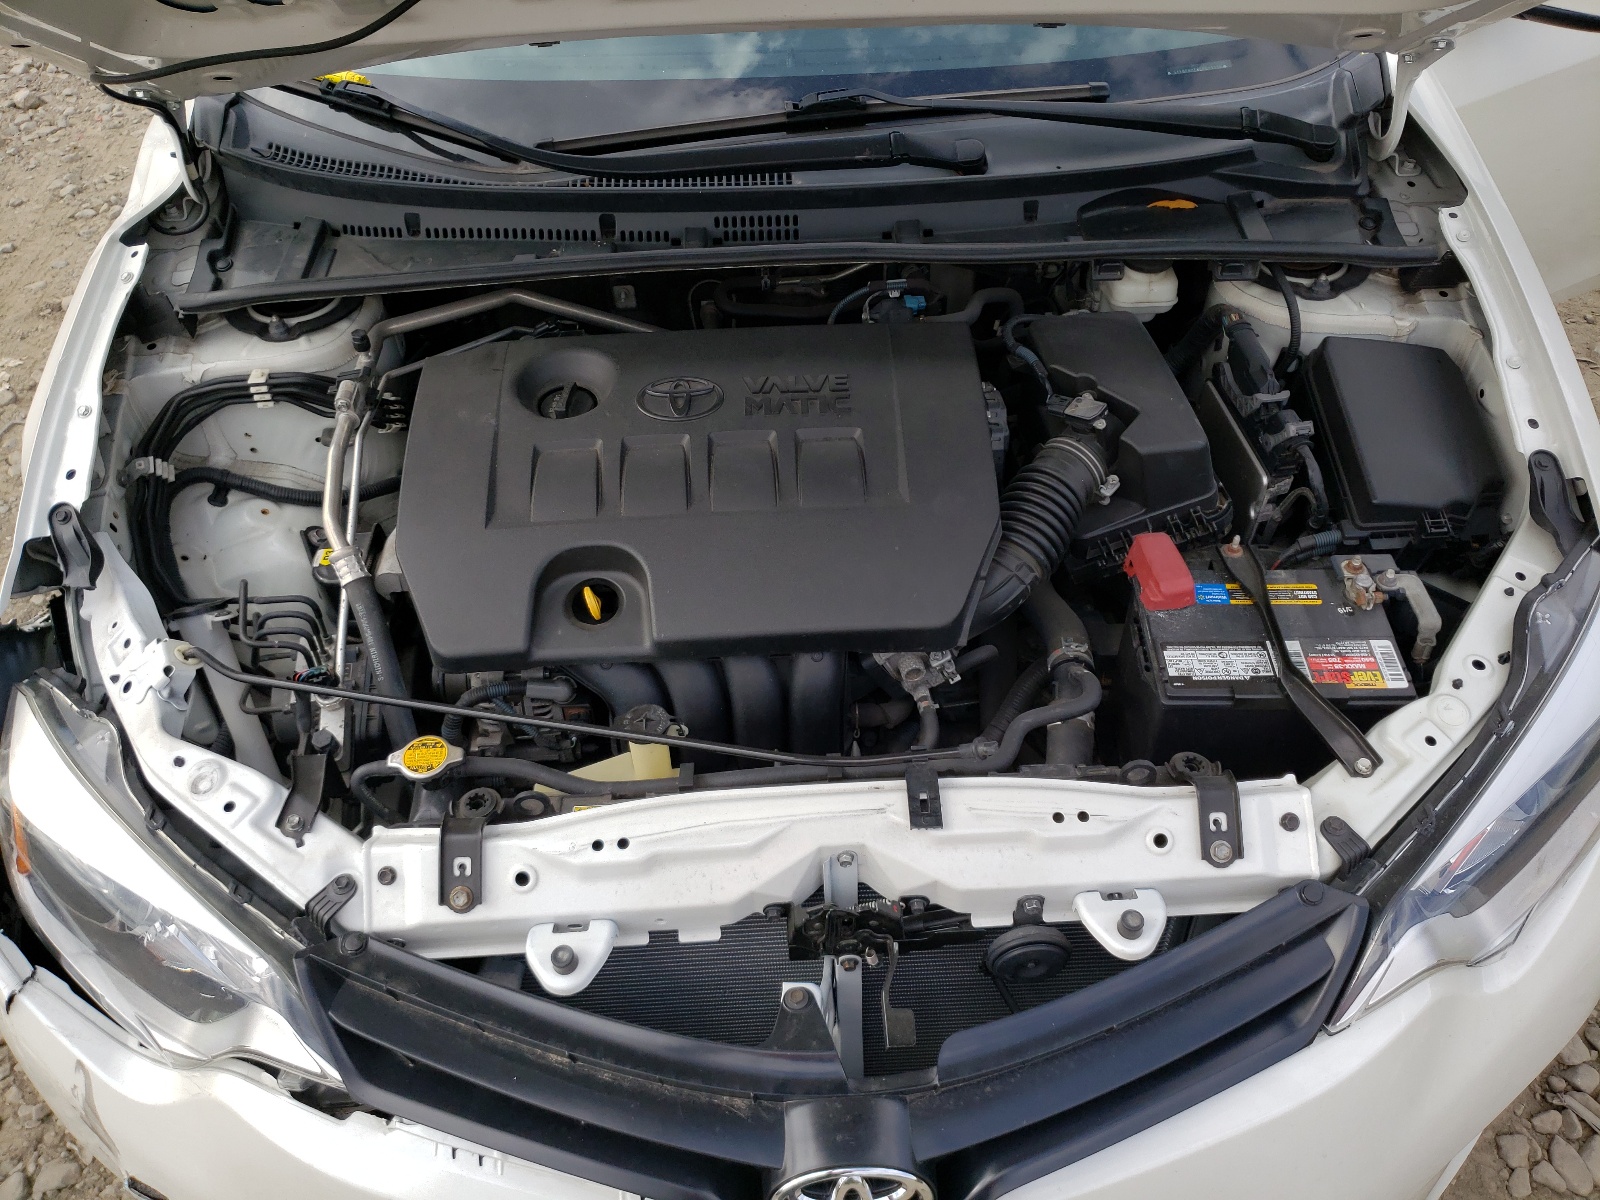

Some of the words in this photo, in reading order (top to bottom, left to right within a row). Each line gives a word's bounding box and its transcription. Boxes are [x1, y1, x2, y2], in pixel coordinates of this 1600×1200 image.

[742, 374, 850, 394] VALVE
[744, 394, 852, 416] MATIC
[1311, 670, 1385, 684] EverStart
